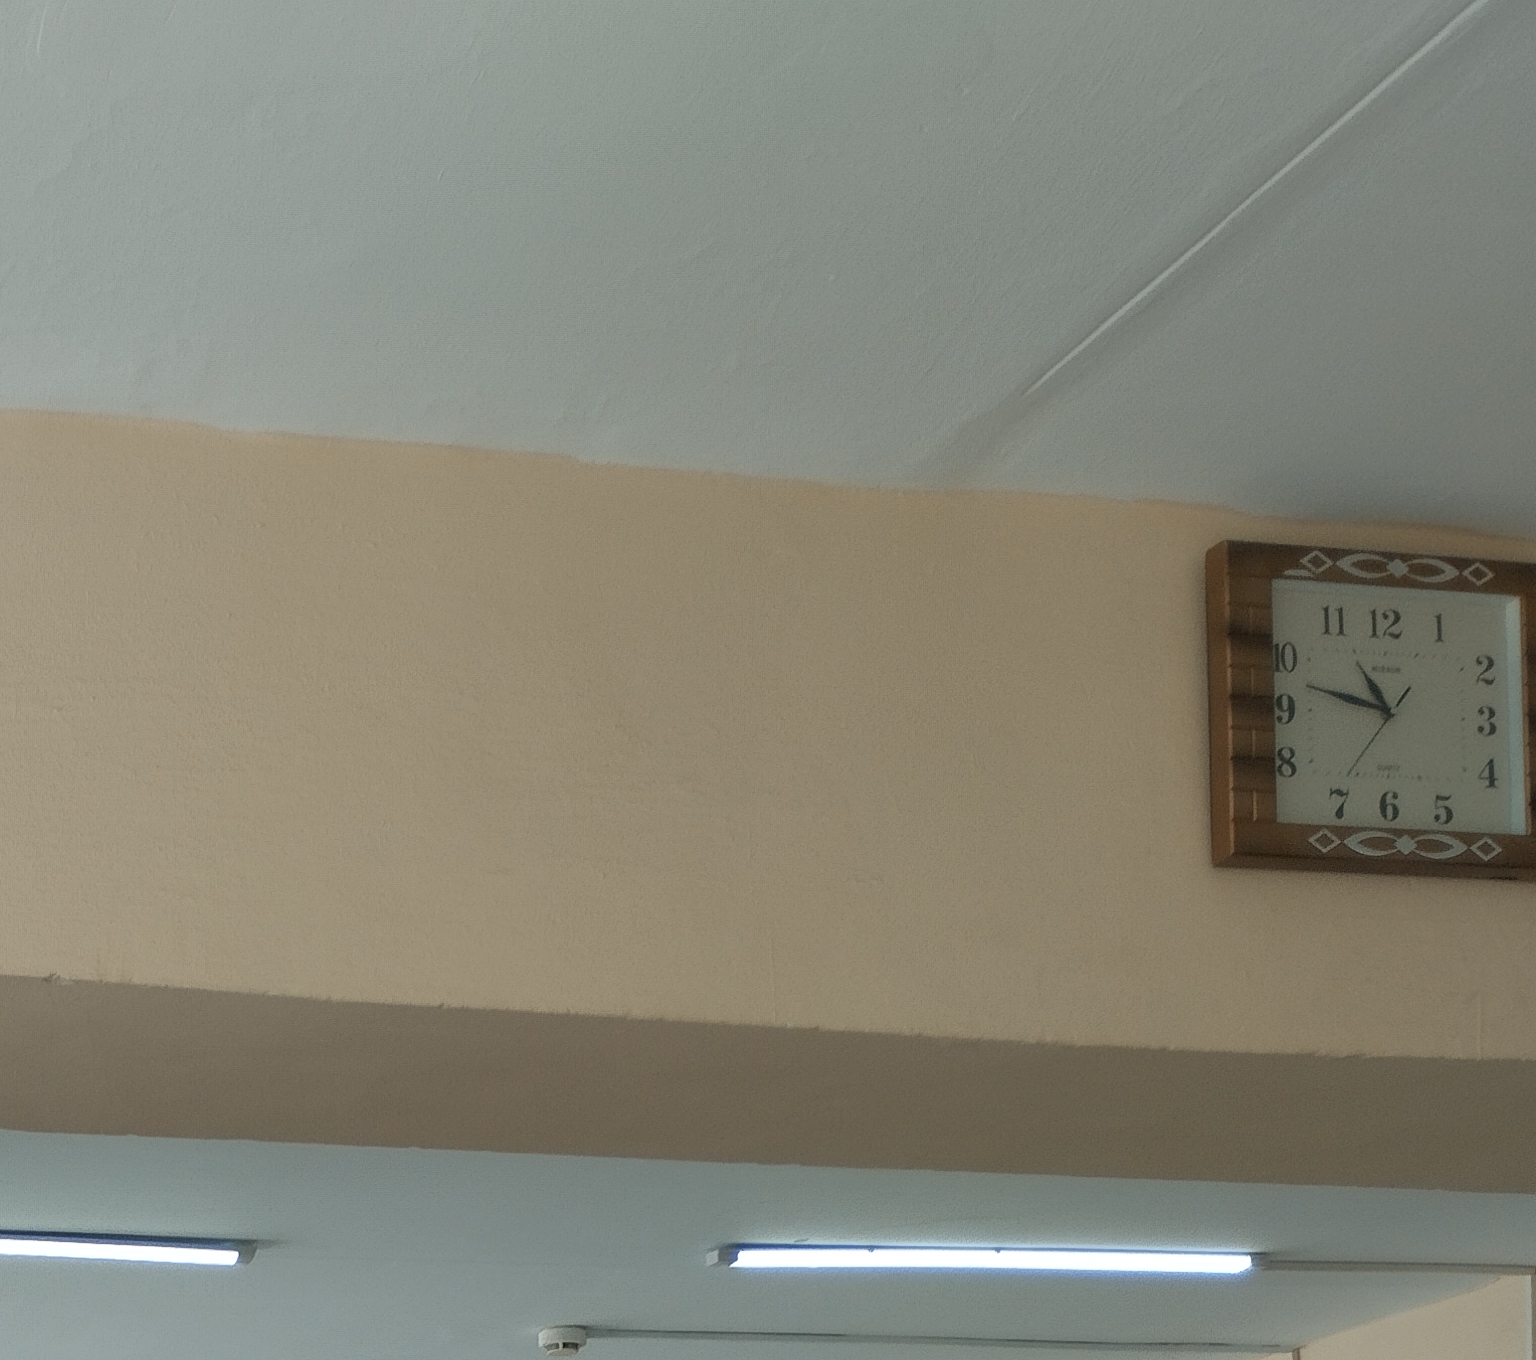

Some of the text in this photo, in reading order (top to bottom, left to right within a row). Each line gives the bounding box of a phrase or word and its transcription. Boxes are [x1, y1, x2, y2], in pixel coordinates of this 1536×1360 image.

[1322, 605, 1346, 636] 11
[1368, 608, 1403, 639] 12
[1433, 613, 1445, 642] 1
[1273, 642, 1297, 673] 10
[1475, 654, 1495, 685] 2
[1275, 693, 1295, 725] 9
[1477, 705, 1497, 736] 3
[1276, 747, 1297, 778] 8
[1477, 758, 1498, 789] 4
[1329, 787, 1349, 820] 7
[1379, 791, 1399, 822] 6
[1433, 794, 1453, 825] 5
